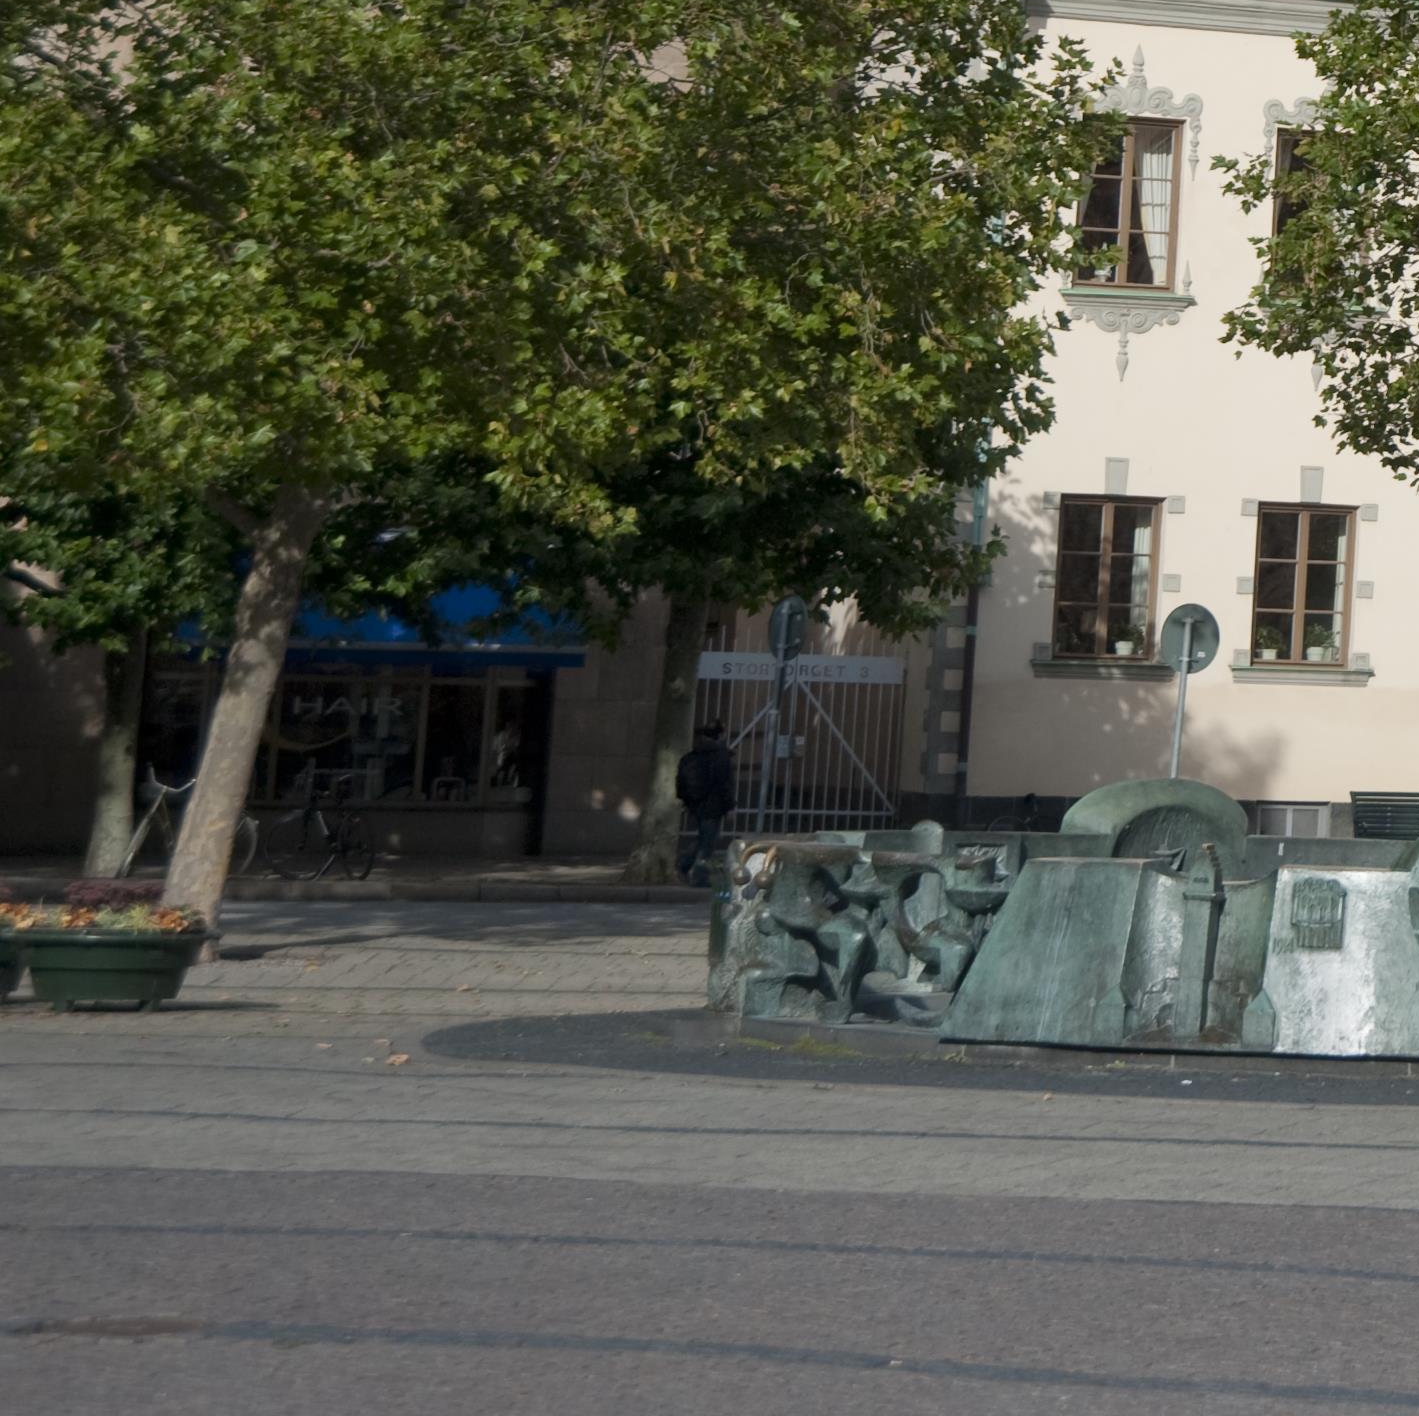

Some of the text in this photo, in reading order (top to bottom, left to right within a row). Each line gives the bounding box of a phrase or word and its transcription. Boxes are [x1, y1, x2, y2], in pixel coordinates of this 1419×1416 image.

[722, 662, 871, 679] STORORGET 3
[293, 695, 404, 716] HAIR
